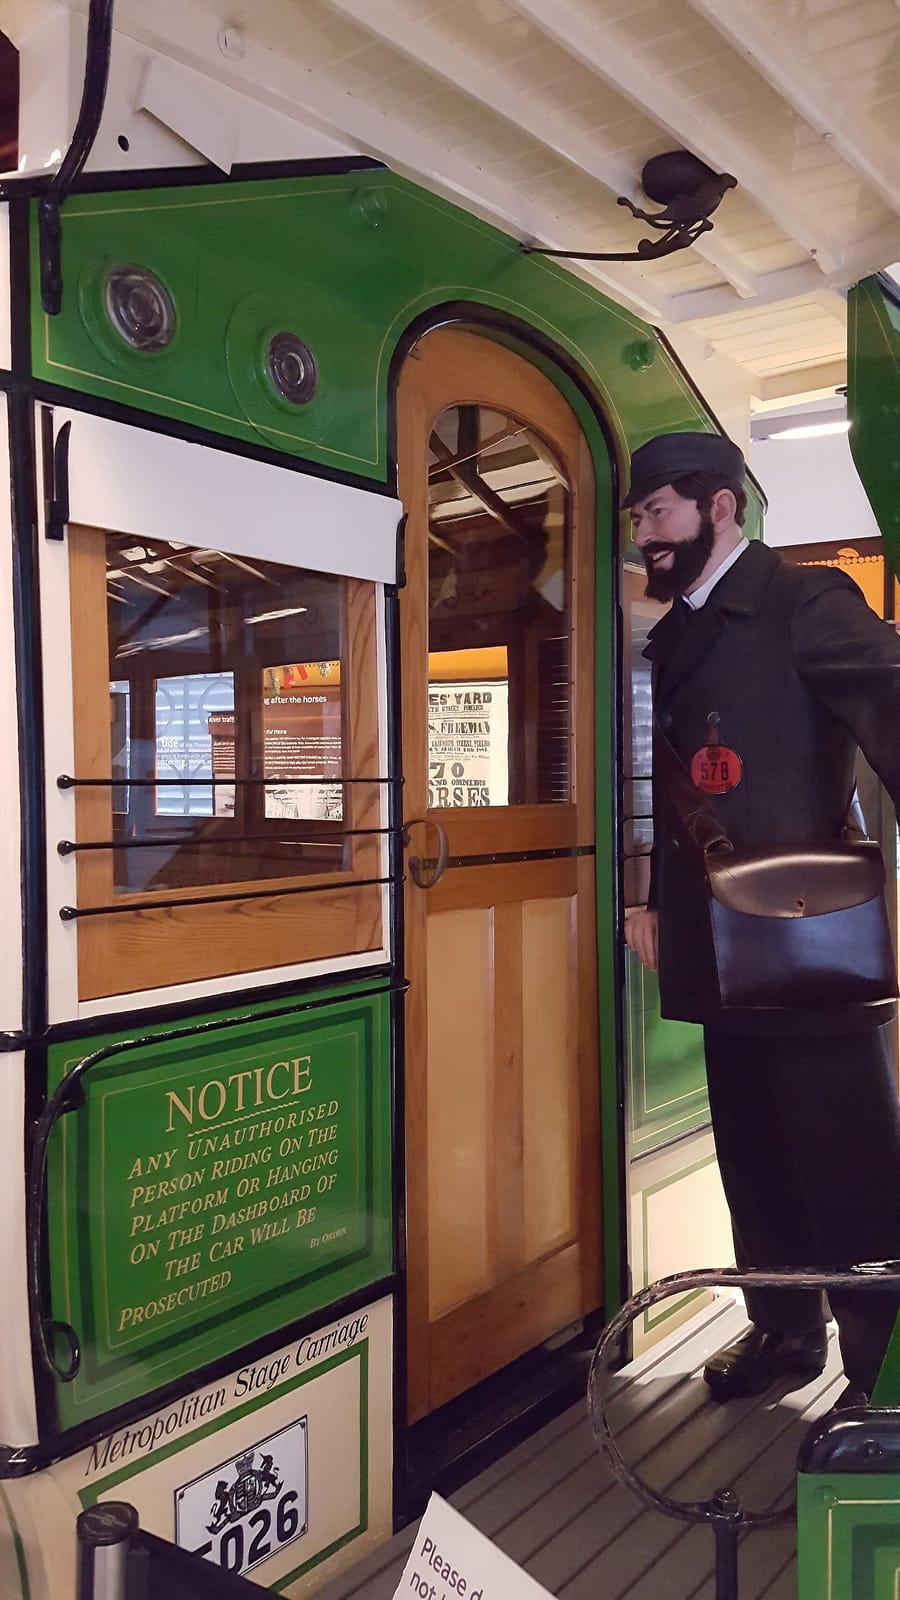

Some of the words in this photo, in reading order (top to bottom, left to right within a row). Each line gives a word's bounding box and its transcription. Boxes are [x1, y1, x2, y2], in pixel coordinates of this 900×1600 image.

[271, 696, 288, 704] after
[303, 695, 327, 703] horses
[455, 692, 492, 704] YARD
[701, 762, 729, 781] 578
[165, 1055, 313, 1132] NOTICE
[128, 1149, 177, 1180] ANY
[188, 1100, 338, 1161] UNAUTHORISED
[130, 1171, 205, 1208] PERSON
[210, 1147, 272, 1181] RIDING
[279, 1137, 303, 1158] ON
[308, 1125, 338, 1149] THE
[130, 1187, 229, 1237] PLATFORM
[237, 1177, 260, 1199] OR
[266, 1150, 338, 1186] HANGING
[130, 1240, 161, 1266] ON
[168, 1225, 204, 1251] THE
[210, 1185, 310, 1235] DASHBOARD
[316, 1174, 337, 1195] OF
[165, 1252, 201, 1281] THE
[209, 1236, 244, 1263] CAR
[250, 1217, 290, 1246] WILL
[296, 1207, 317, 1229] BE
[117, 1270, 232, 1332] PROSECUTED
[84, 1387, 226, 1476] Metropolitan
[234, 1353, 290, 1398] Stage
[296, 1313, 369, 1366] Carriage
[410, 1571, 437, 1599] not
[420, 1536, 468, 1597] Please
